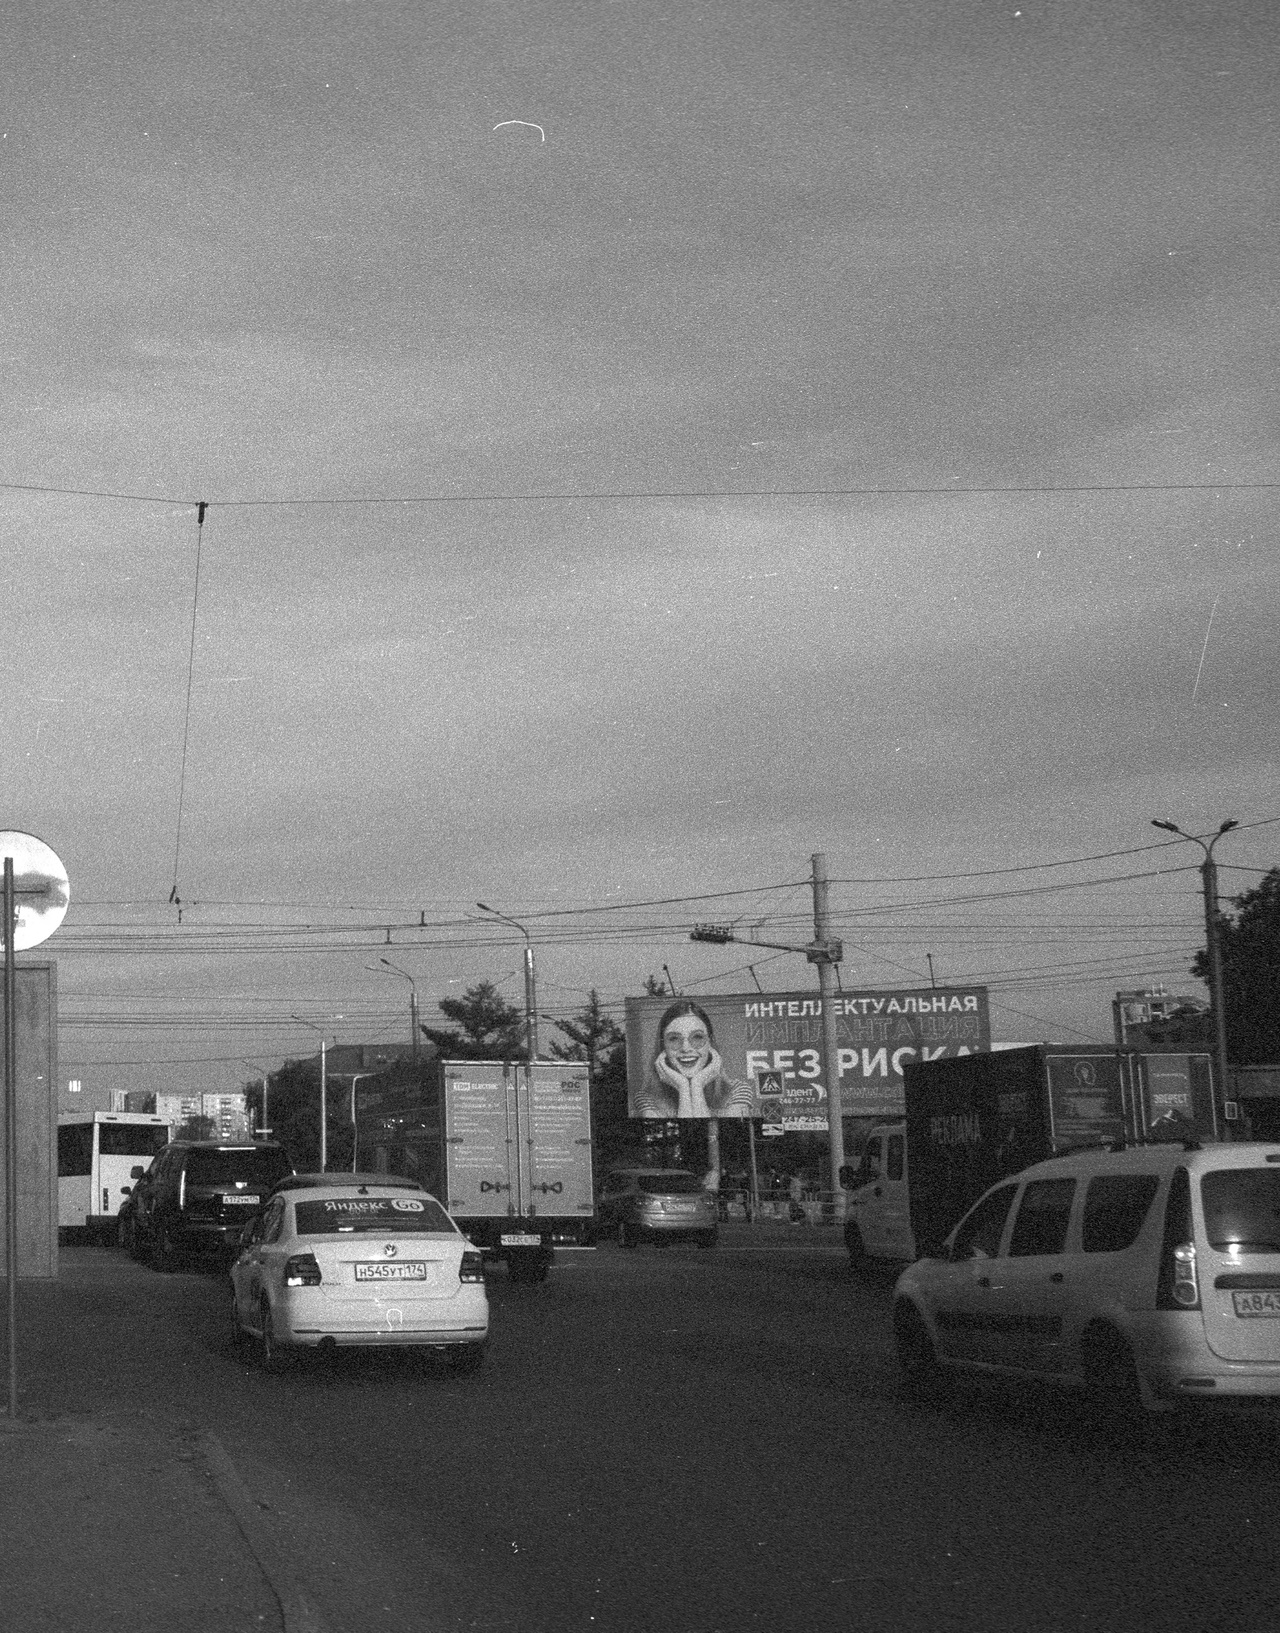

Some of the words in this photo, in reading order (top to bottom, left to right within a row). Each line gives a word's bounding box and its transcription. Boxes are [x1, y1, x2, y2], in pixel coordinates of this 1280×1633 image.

[745, 1048, 822, 1079] БЕЗ
[324, 1200, 388, 1212] Яндекс
[395, 1199, 420, 1210] Go
